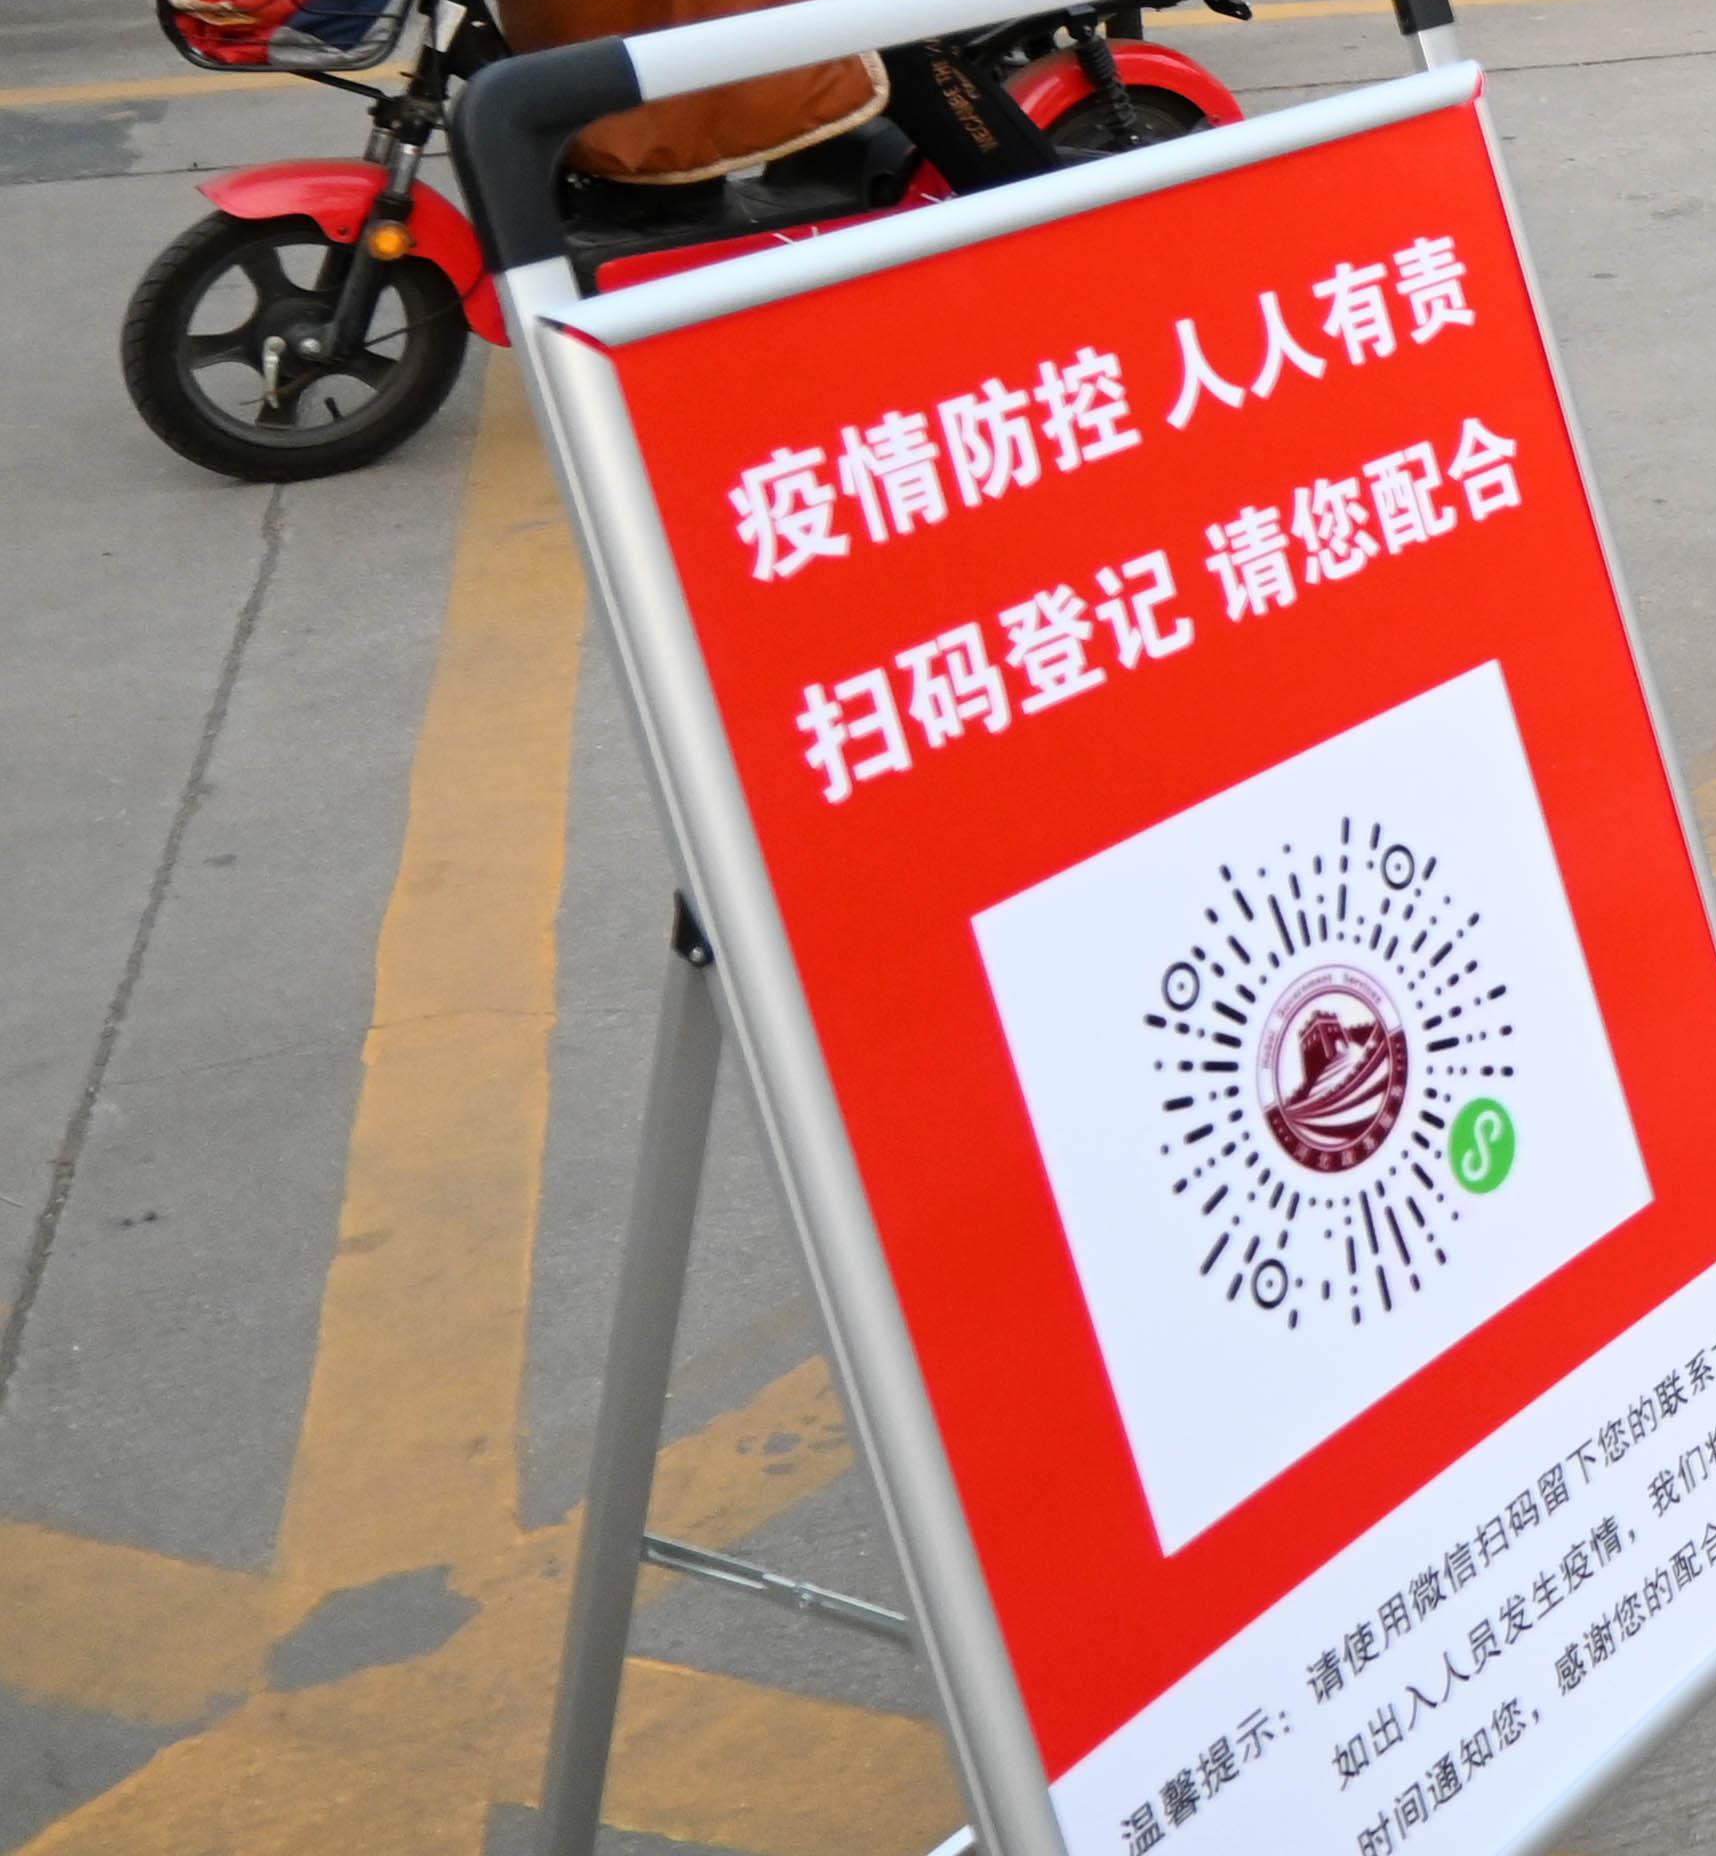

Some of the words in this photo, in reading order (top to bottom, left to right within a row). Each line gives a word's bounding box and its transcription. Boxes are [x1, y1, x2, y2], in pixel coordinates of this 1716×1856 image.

[727, 346, 1140, 581] 疫情防控
[1166, 236, 1477, 429] 人人有责
[797, 549, 1194, 805] 扫码登记
[1207, 417, 1523, 624] 请您配合
